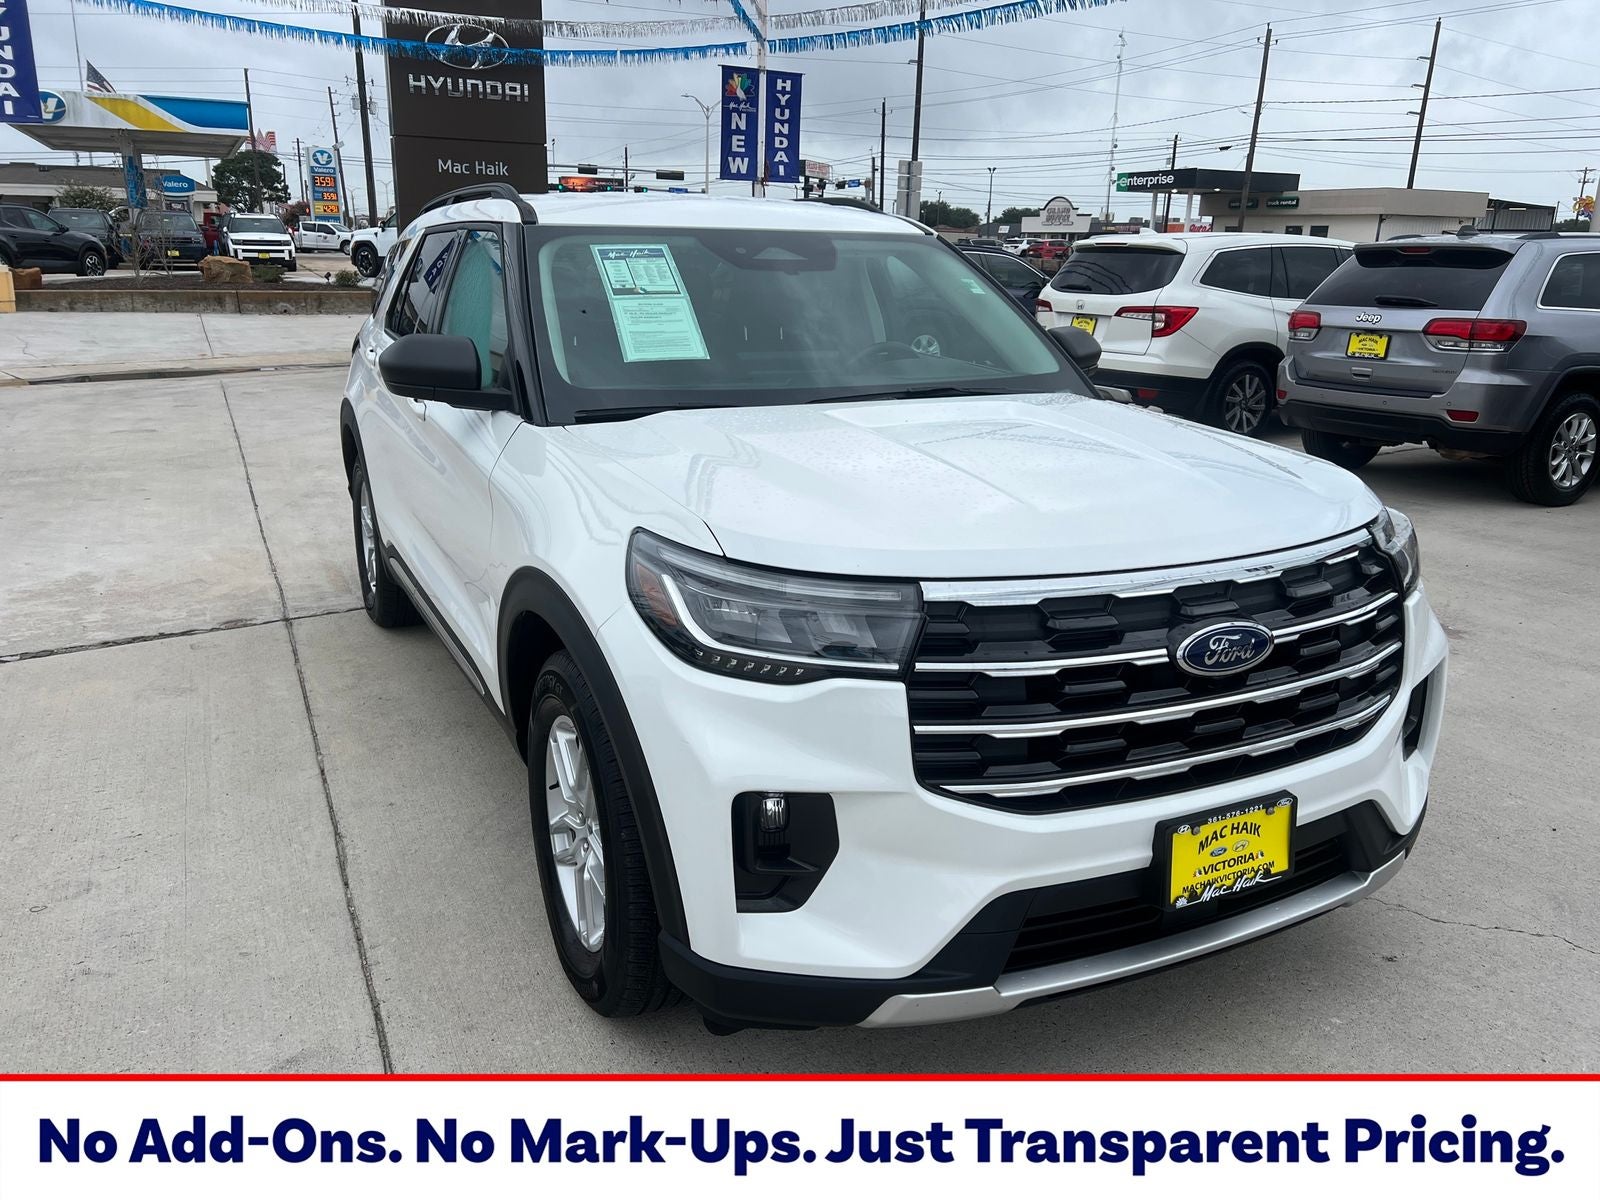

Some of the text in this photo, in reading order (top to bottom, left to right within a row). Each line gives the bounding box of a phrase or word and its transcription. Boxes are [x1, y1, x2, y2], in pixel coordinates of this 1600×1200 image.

[408, 73, 529, 102] HYUNDAI
[773, 79, 792, 176] HYUNDAI
[728, 112, 749, 174] NEW
[313, 166, 334, 174] Valero
[438, 158, 509, 176] Mac Haik
[162, 180, 189, 189] Valero
[1119, 173, 1175, 188] enterprise
[1356, 312, 1382, 324] Jeep
[1204, 633, 1255, 666] Ford
[1207, 804, 1263, 825] 361-576-1221
[1198, 821, 1261, 855] MAC HAIK
[1202, 852, 1255, 875] VICTORIA
[1200, 884, 1231, 902] Mac
